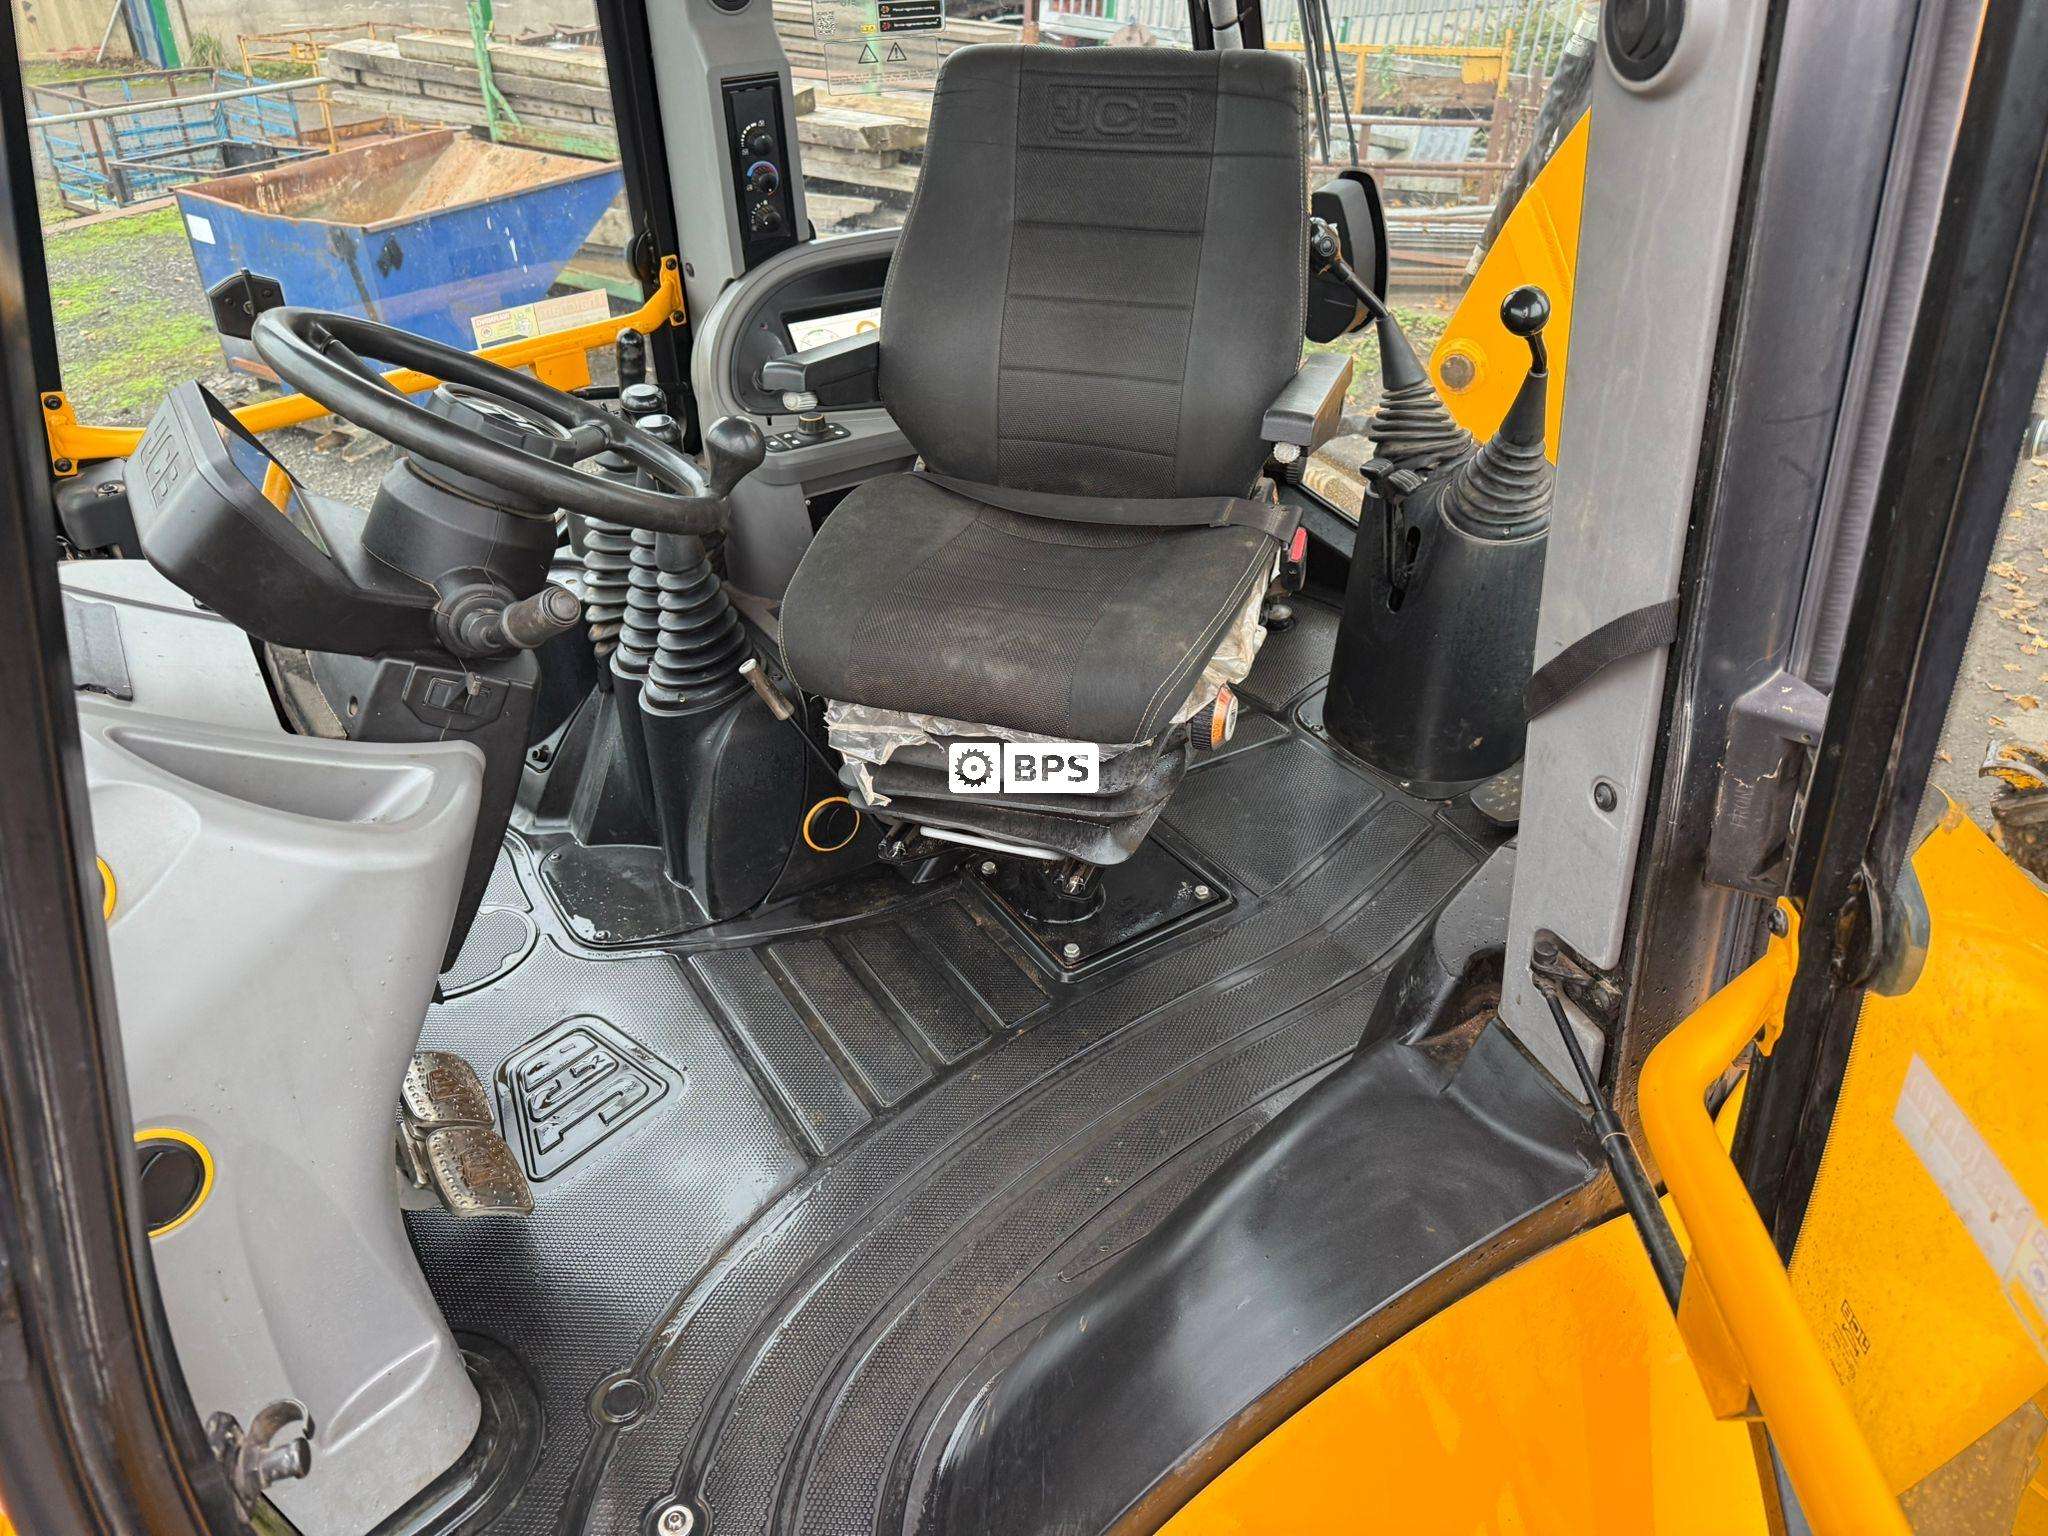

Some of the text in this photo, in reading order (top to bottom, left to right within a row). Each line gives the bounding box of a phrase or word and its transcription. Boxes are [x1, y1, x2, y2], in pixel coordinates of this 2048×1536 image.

[1051, 95, 1187, 137] JCB
[141, 415, 182, 509] JCB
[521, 1033, 650, 1156] JCB
